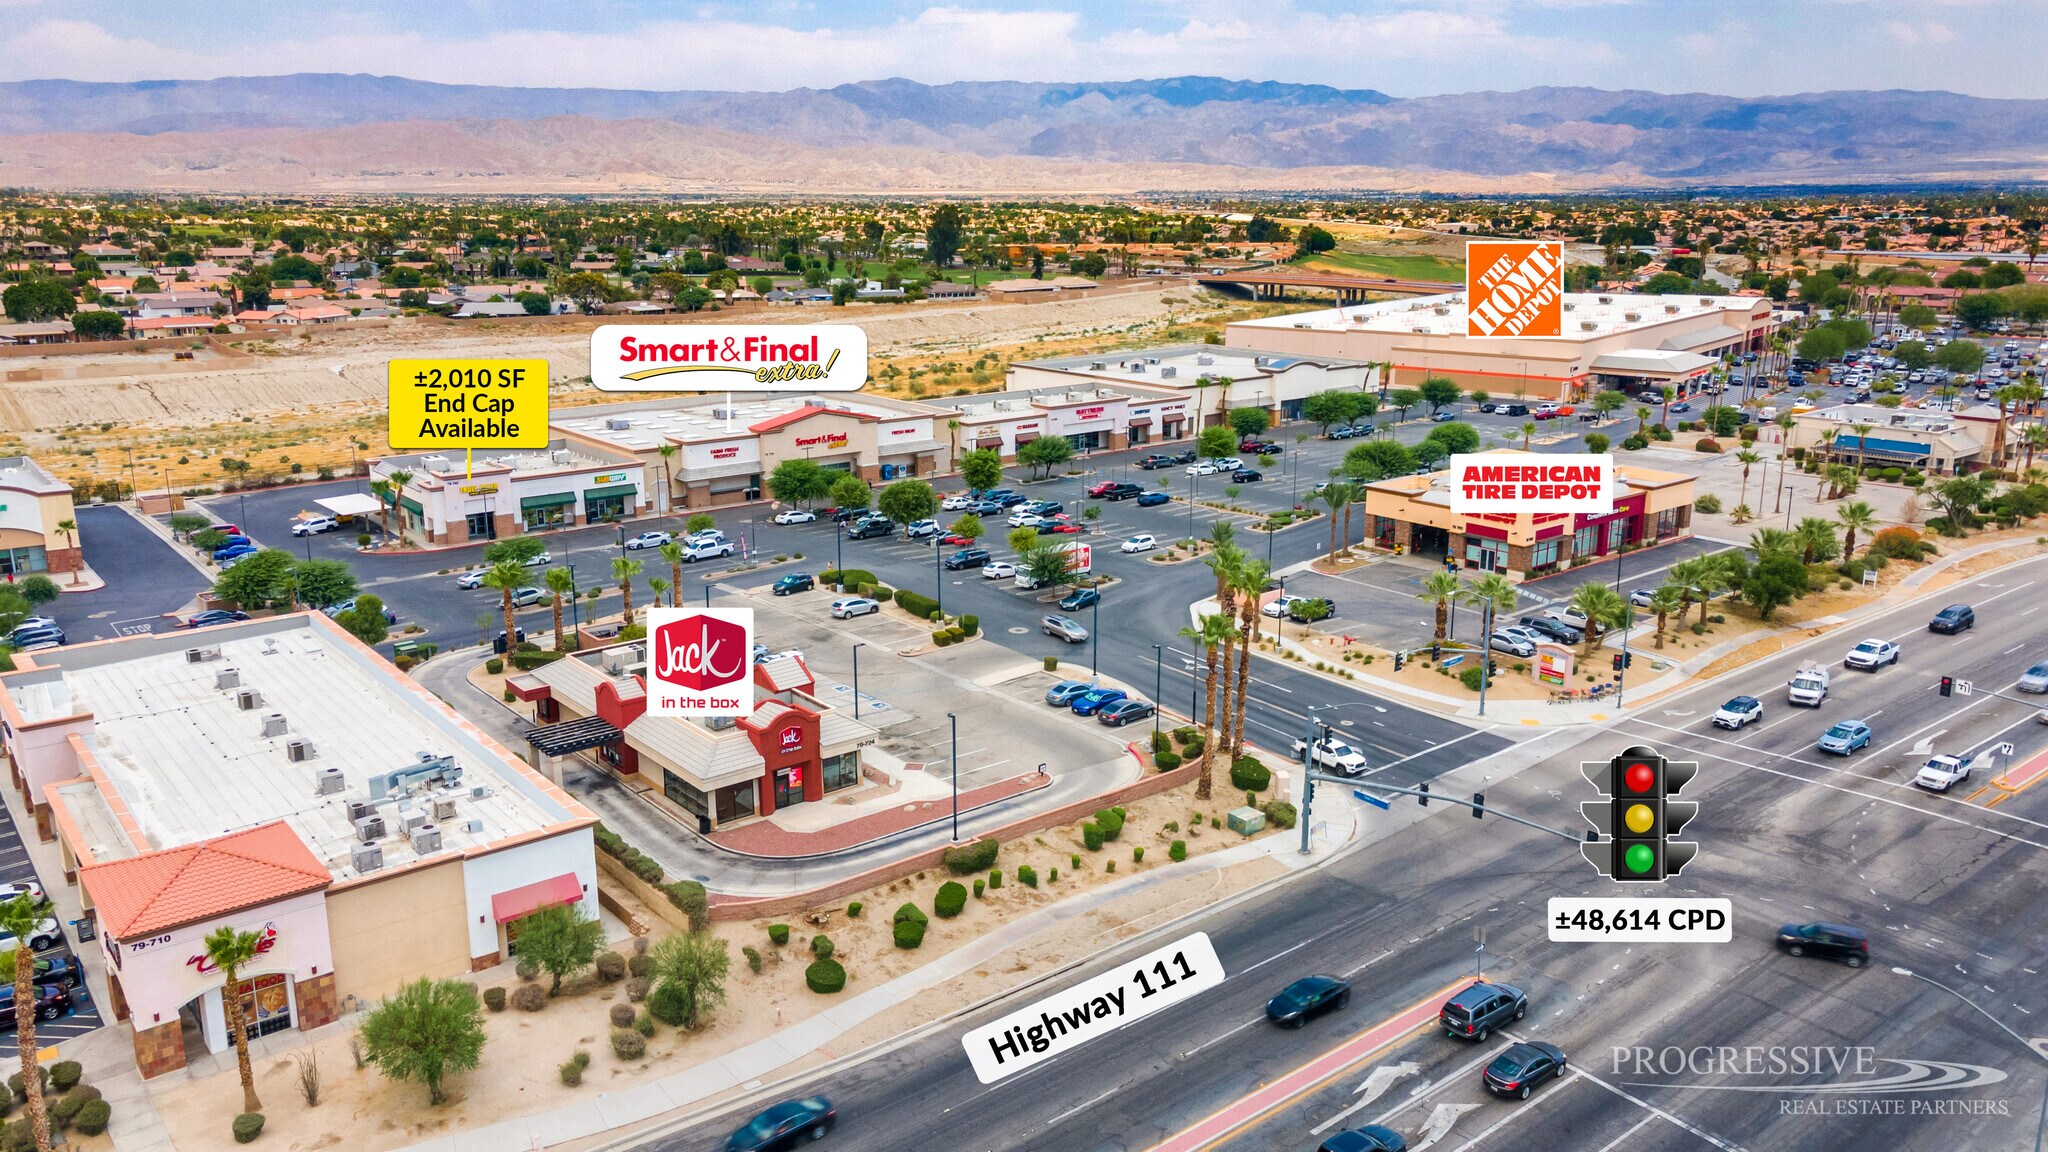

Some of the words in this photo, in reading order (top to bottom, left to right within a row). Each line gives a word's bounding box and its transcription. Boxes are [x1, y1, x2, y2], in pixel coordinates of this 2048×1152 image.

[596, 474, 626, 484] SUBWAY
[122, 624, 151, 635] STOP
[782, 729, 801, 745] Jack
[131, 935, 171, 951] 79-710
